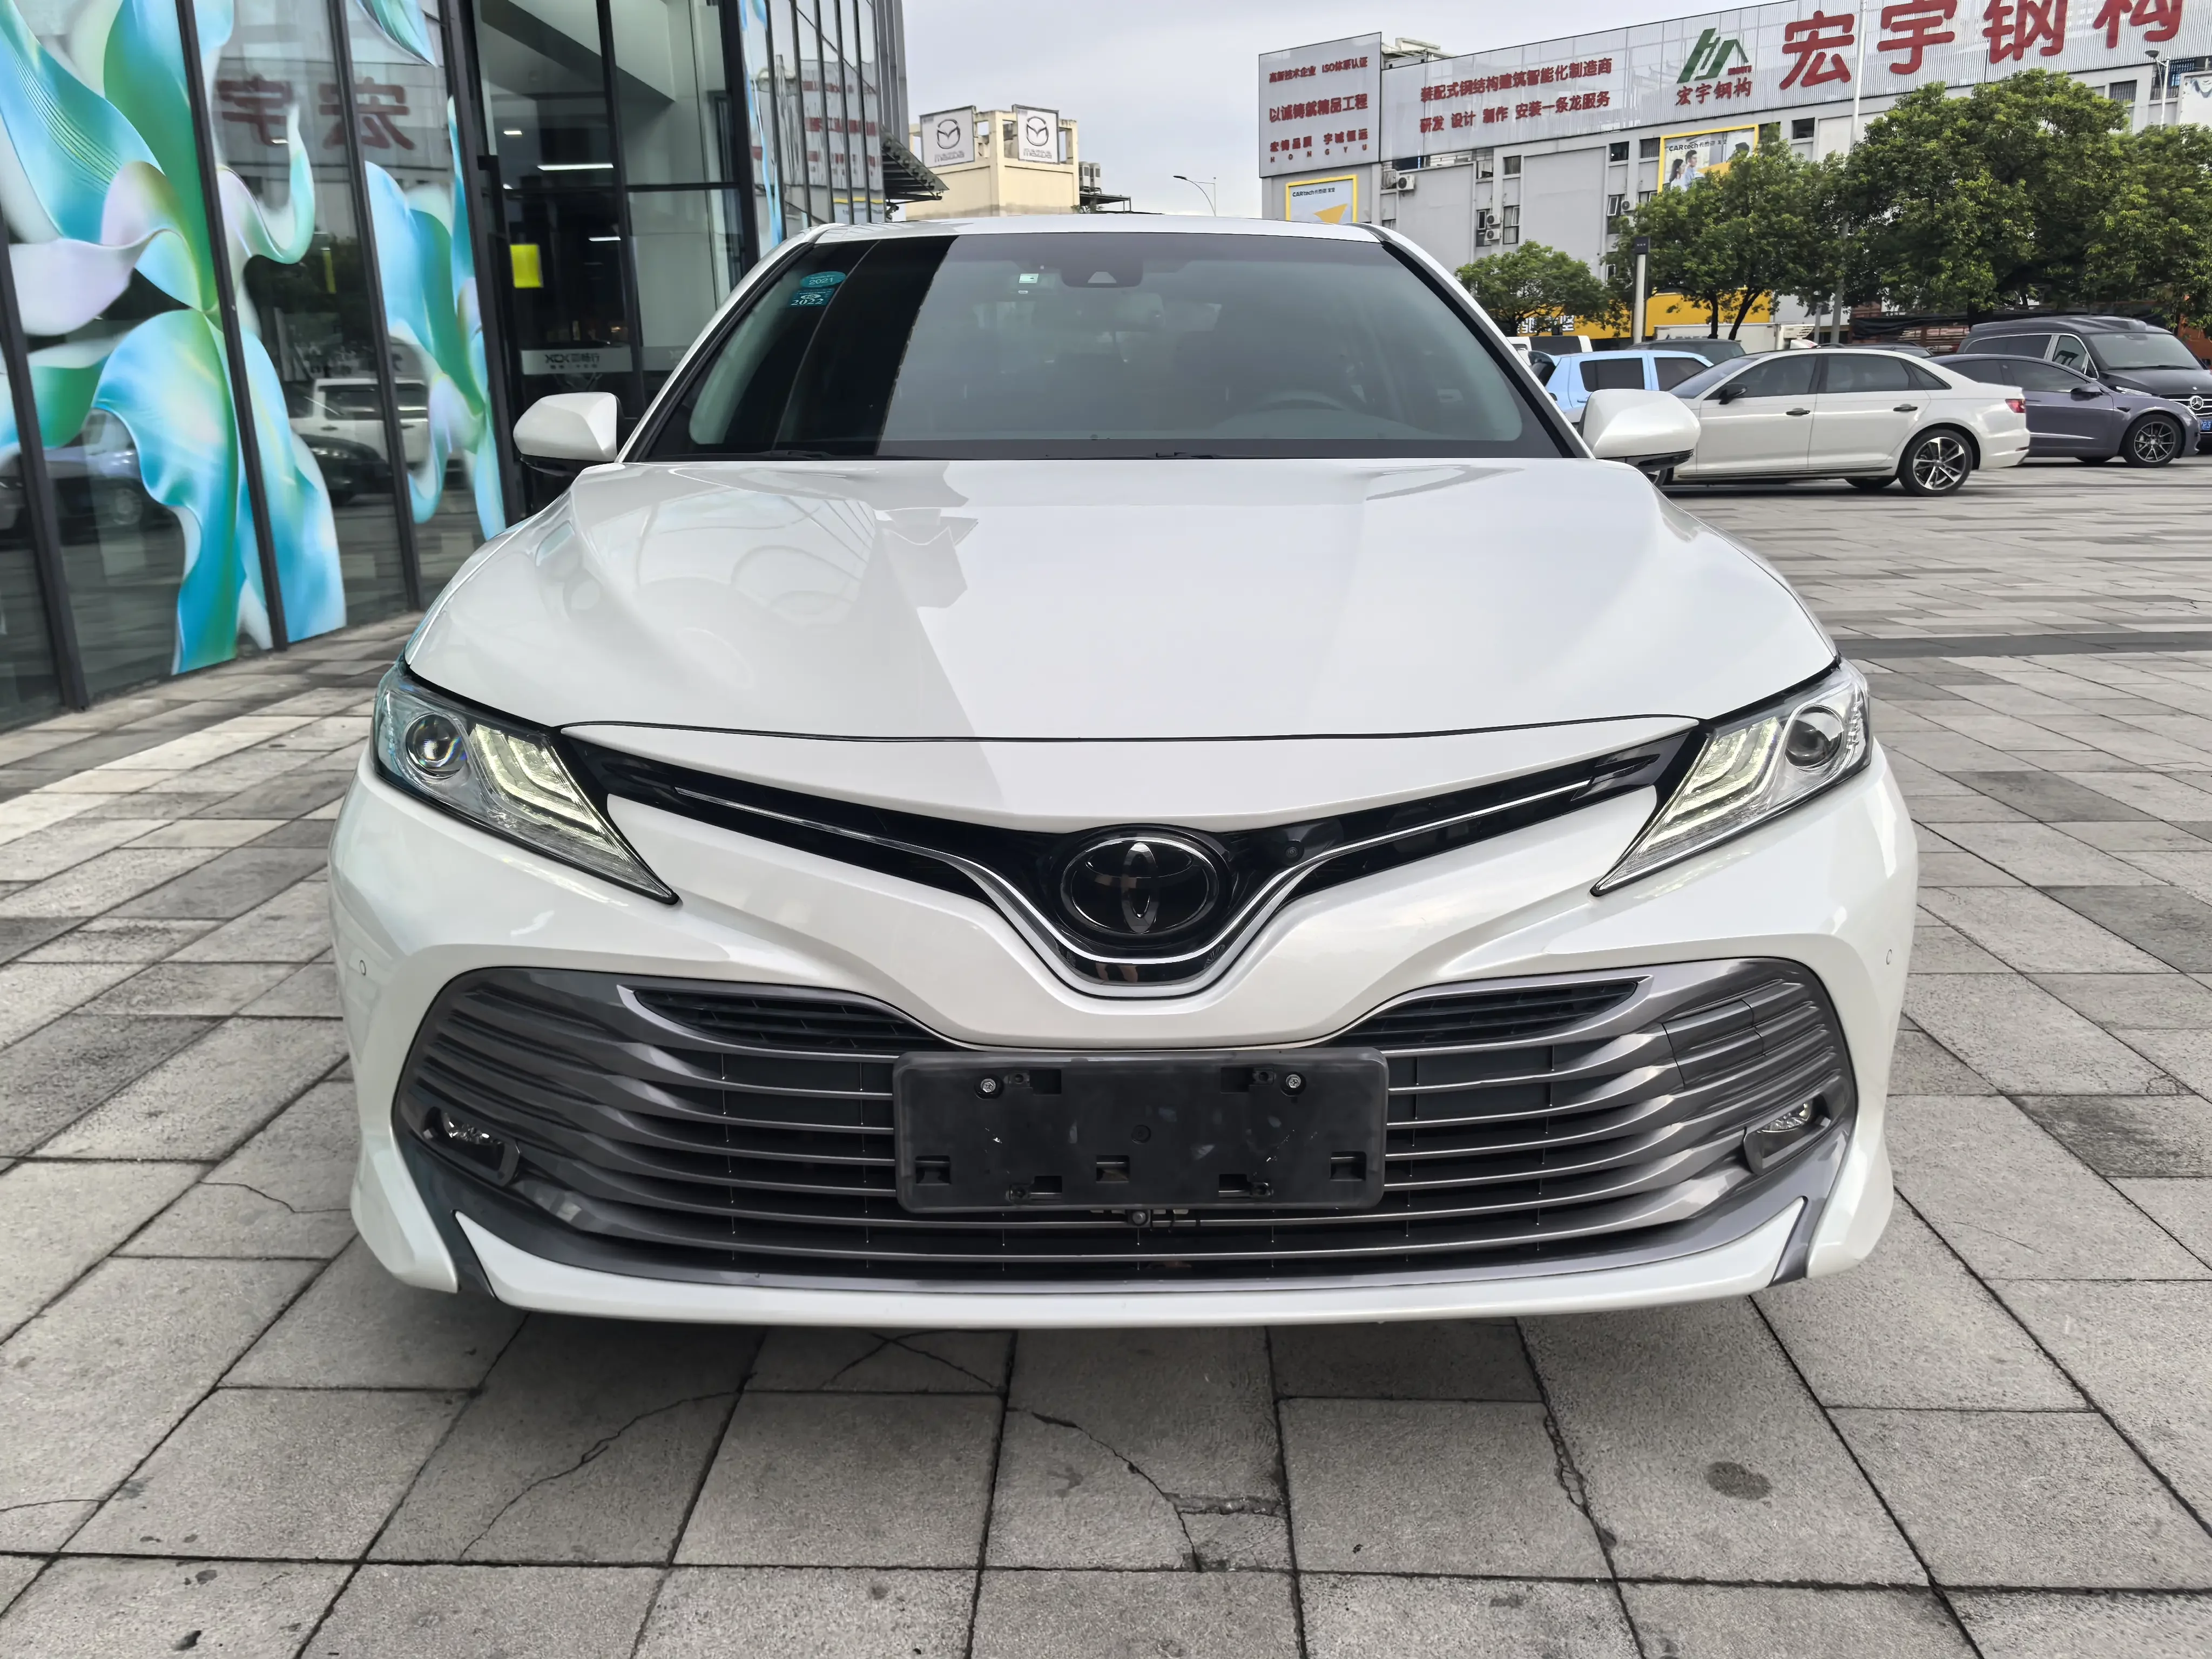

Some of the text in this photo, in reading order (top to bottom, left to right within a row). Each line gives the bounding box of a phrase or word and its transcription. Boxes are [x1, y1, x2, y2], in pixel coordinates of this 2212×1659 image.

[1779, 0, 2182, 90] 宏宇钢构
[1269, 65, 1317, 83] 高新技术企业
[1421, 58, 1612, 103] 装配式钢结构建筑智能化制造商
[1675, 77, 1752, 106] 宏宇钢构
[1420, 91, 1610, 133] 研发 设计 制作 安装一条龙服务
